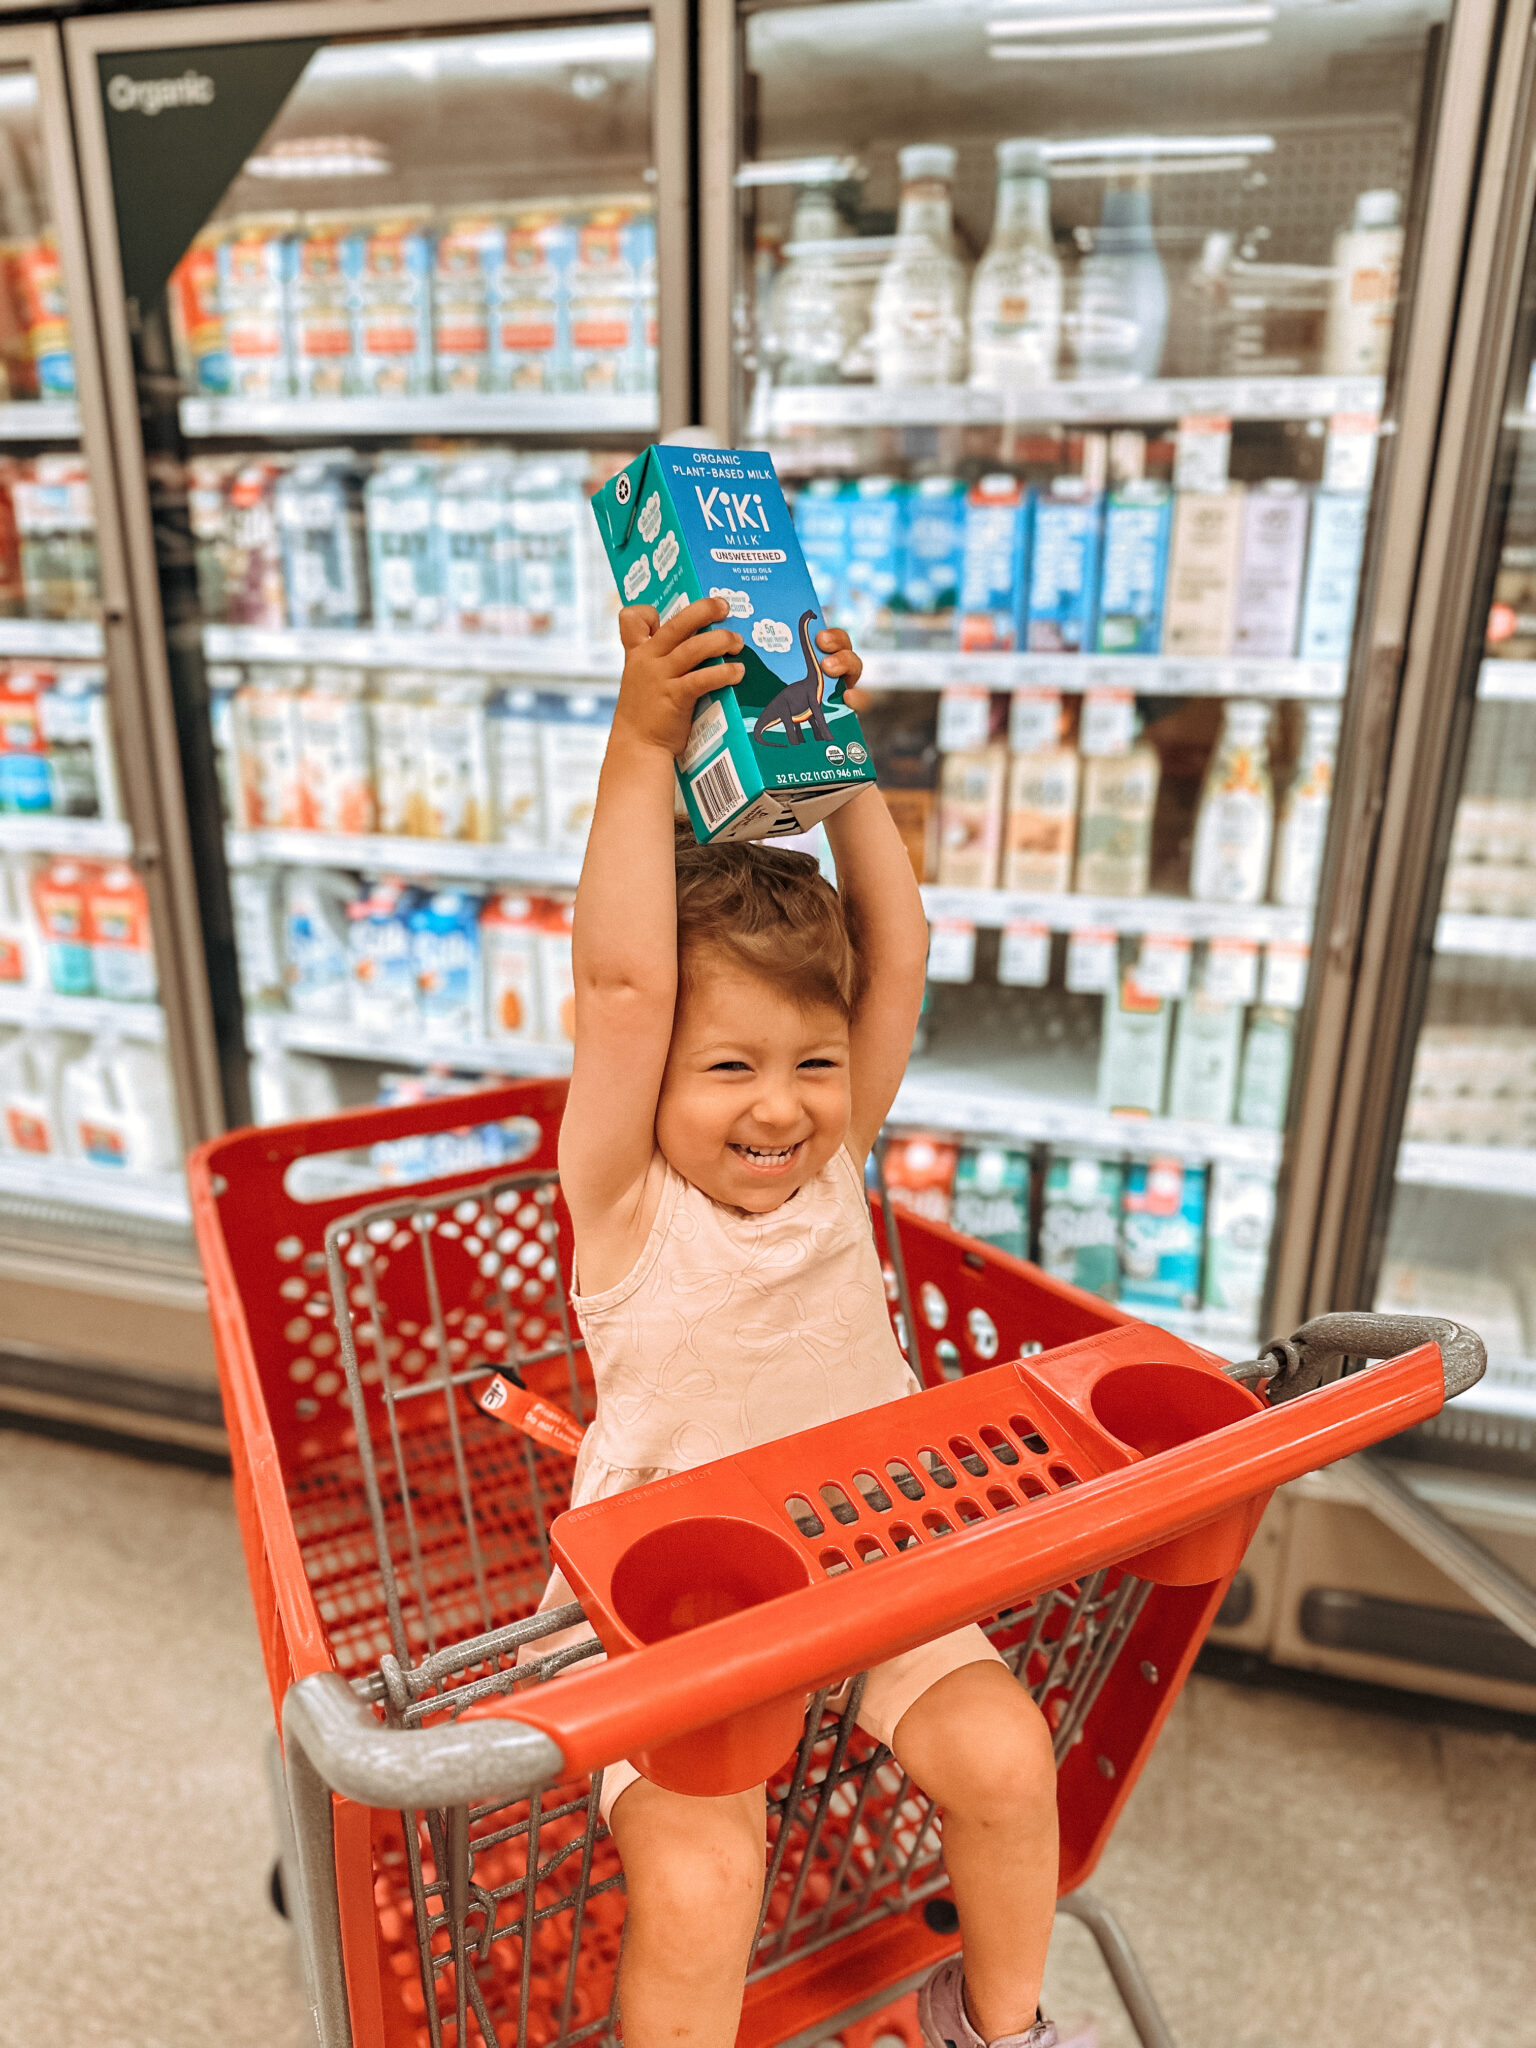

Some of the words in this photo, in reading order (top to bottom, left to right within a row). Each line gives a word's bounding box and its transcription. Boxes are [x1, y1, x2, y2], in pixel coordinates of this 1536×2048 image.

[107, 69, 214, 115] Organic
[692, 453, 741, 466] ORGANIC
[672, 465, 744, 480] PLANT-BASED
[746, 470, 772, 480] MILK
[724, 534, 760, 546] MILK
[715, 551, 781, 561] UNSWEETENED
[764, 624, 775, 636] 5g
[776, 774, 787, 784] 32
[788, 773, 799, 783] FL
[801, 772, 812, 782] OZ
[813, 770, 820, 781] (1
[821, 770, 835, 780] QT)
[836, 770, 851, 779] 946
[852, 768, 866, 777] mL
